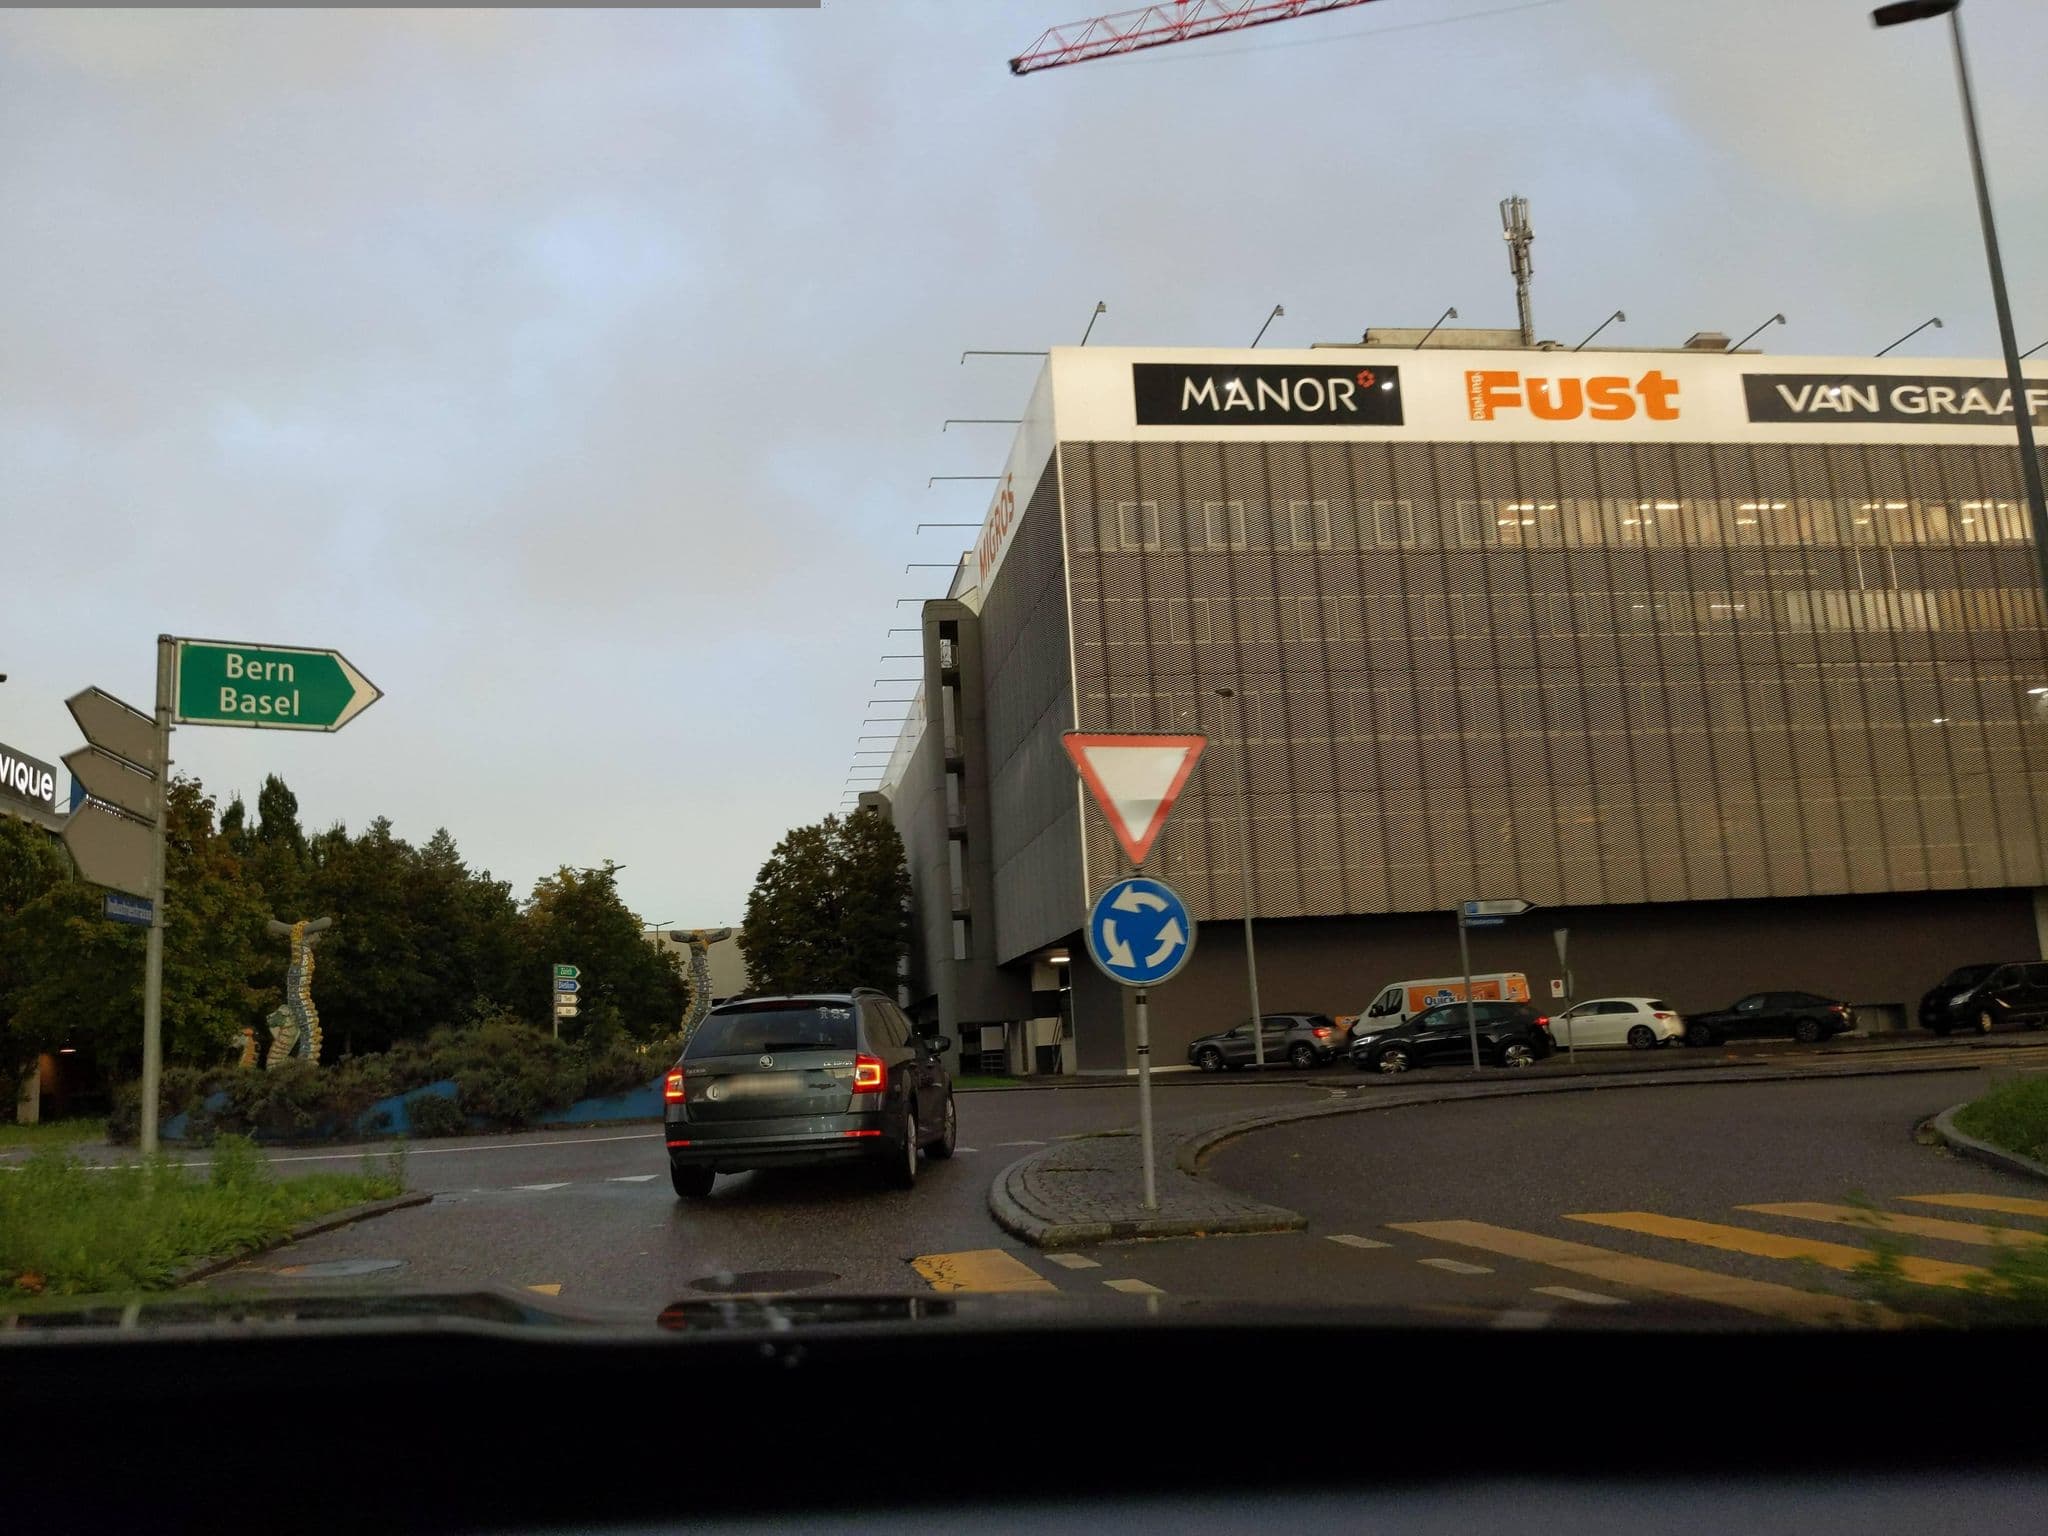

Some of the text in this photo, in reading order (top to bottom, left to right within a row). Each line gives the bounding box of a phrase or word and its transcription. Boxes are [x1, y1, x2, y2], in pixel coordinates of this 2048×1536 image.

[1182, 376, 1358, 412] MANOR
[1775, 384, 1880, 413] VAN
[979, 472, 1015, 589] MIGROS
[226, 653, 295, 682] Bern
[220, 686, 299, 717] Basel
